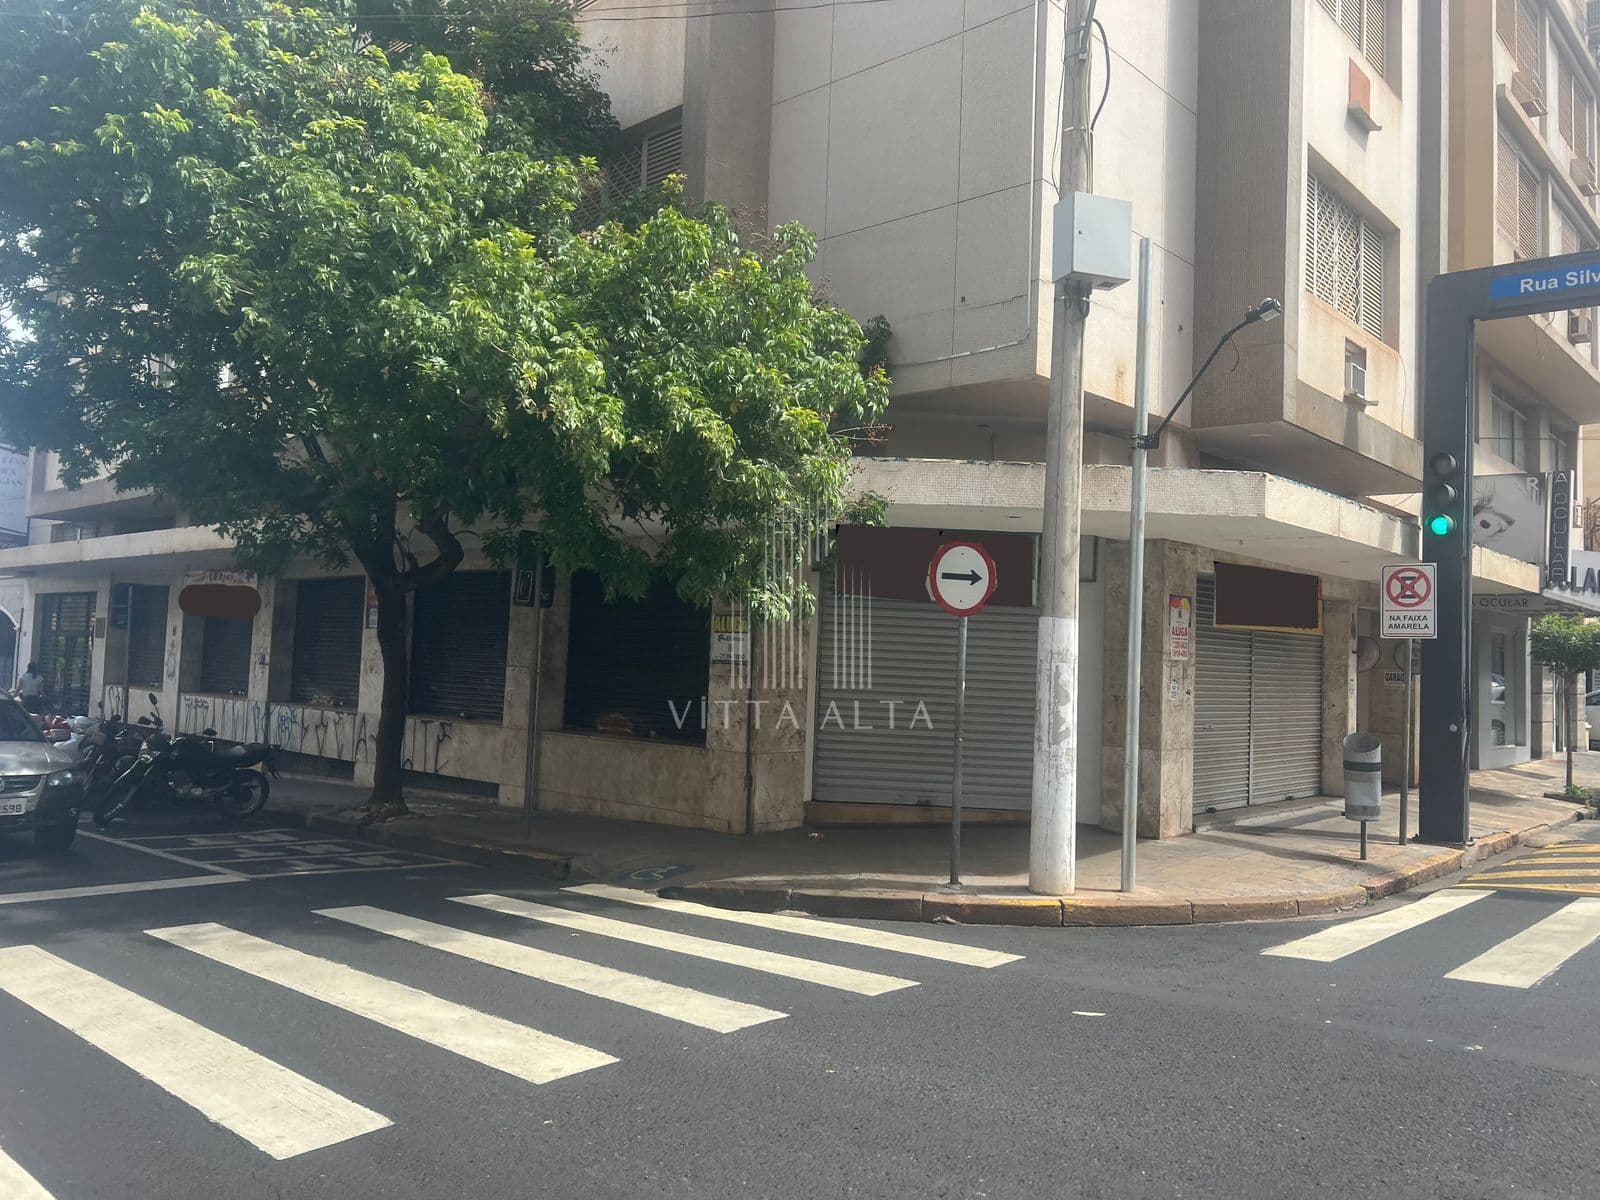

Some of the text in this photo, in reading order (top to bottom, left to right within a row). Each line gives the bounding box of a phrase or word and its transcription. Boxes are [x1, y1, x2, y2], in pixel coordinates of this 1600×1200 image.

[1520, 278, 1558, 293] Rua
[1551, 492, 1568, 580] OCULAR
[1480, 599, 1528, 608] OCULAR
[1389, 614, 1428, 622] NA FAIXA
